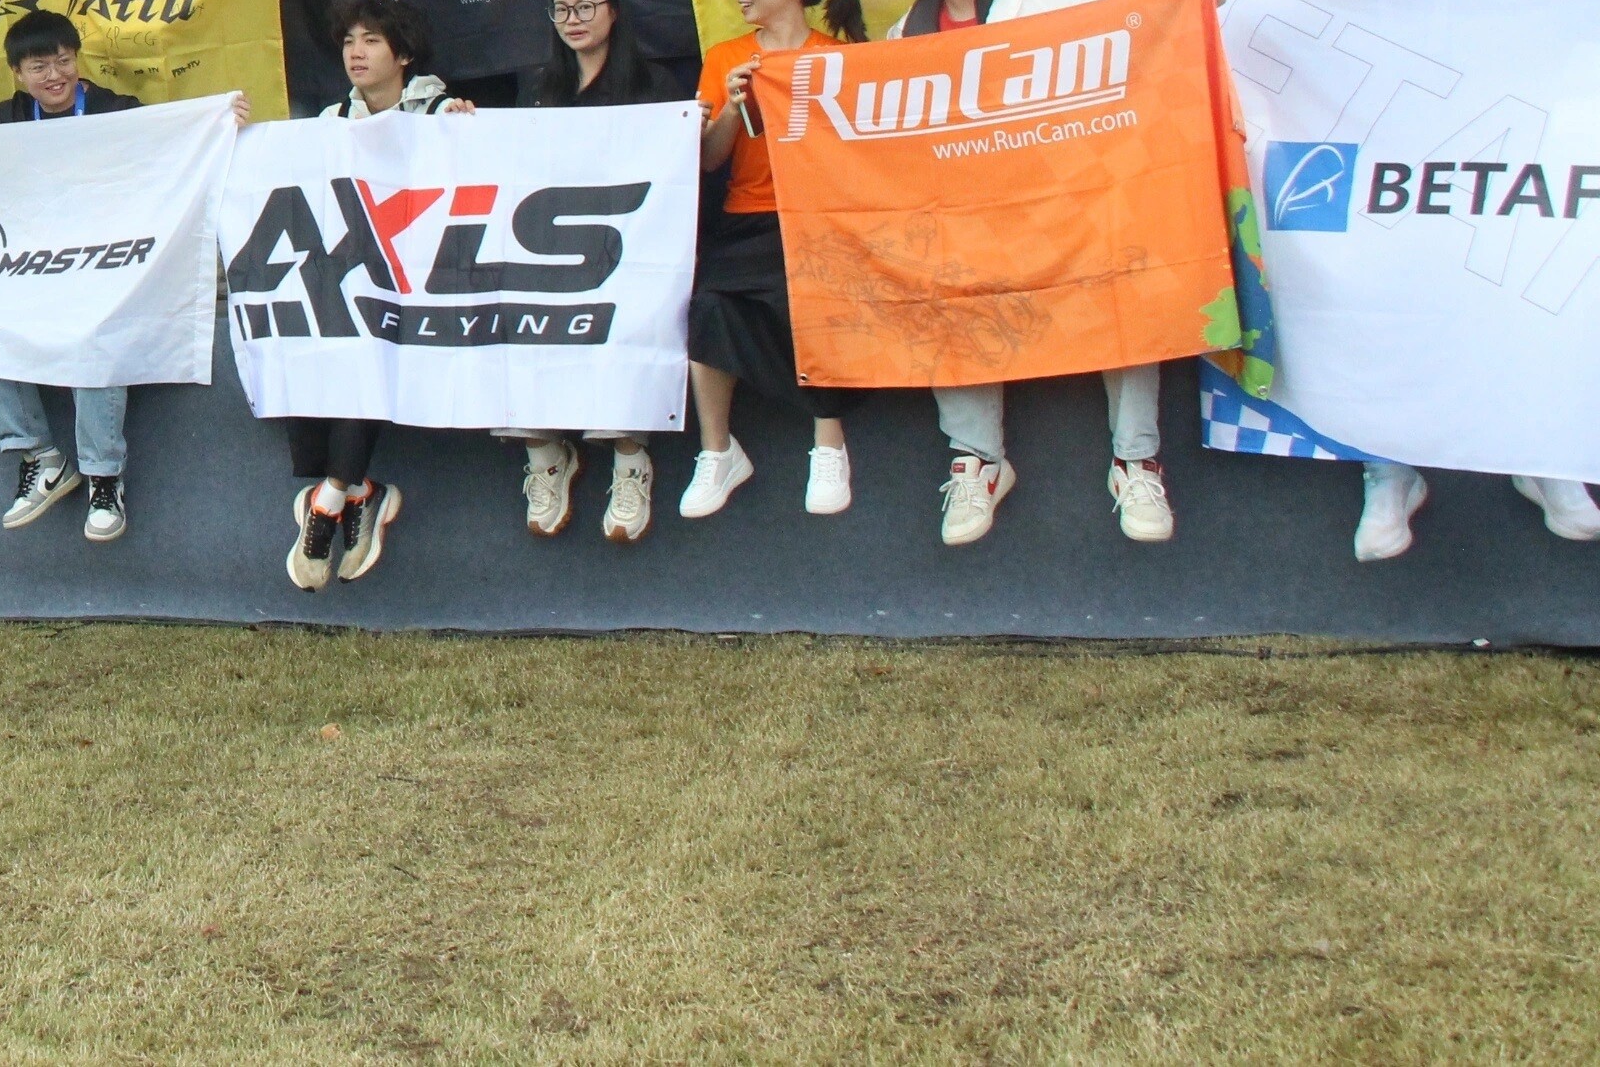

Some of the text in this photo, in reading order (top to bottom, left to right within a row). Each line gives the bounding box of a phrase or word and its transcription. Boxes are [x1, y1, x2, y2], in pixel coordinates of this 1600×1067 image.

[777, 29, 1131, 142] RunCam
[932, 107, 1137, 159] www.RunCam.com
[381, 311, 594, 336] FLYING
